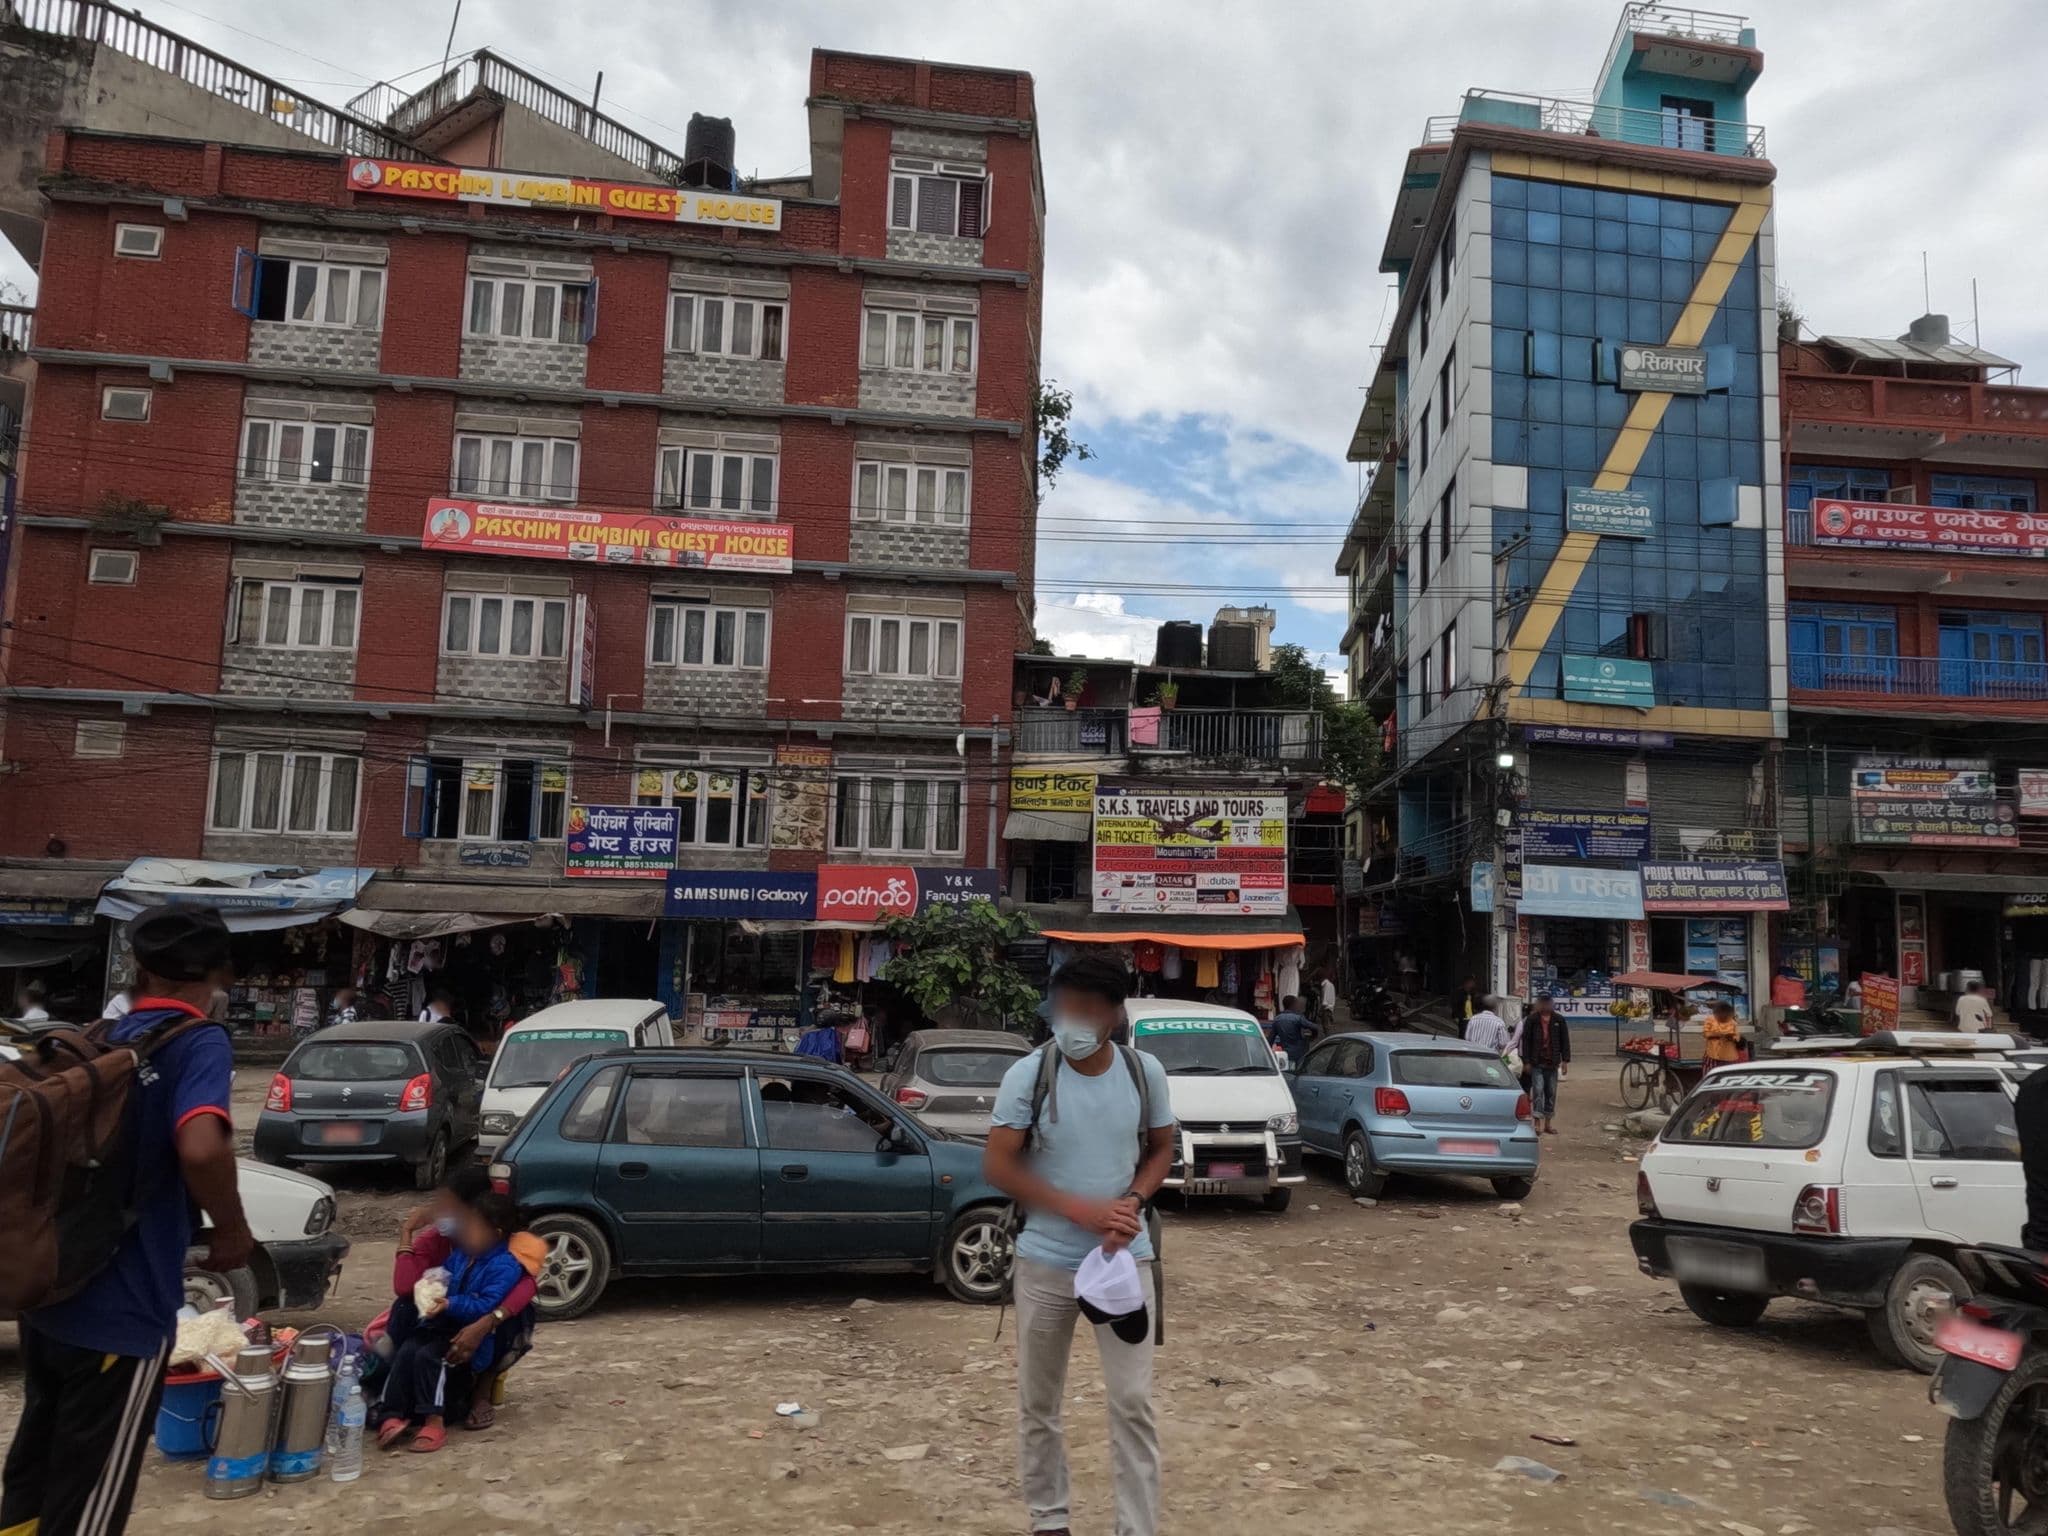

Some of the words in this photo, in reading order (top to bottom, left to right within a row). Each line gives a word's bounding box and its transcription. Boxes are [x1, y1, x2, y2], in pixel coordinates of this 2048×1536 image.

[384, 166, 492, 197] PASCHIM
[502, 178, 602, 208] LUMBINI
[609, 188, 685, 215] GUEST
[696, 198, 776, 225] HOUSE
[1641, 351, 1706, 374] सिमसार
[475, 517, 561, 541] PASCHIM
[567, 523, 651, 548] LUMBINI
[656, 530, 720, 551] GUEST
[724, 535, 789, 556] HOUSE
[1053, 773, 1092, 792] टिकट
[1900, 783, 1924, 792] HOME
[1098, 799, 1133, 816] S.K.S.
[1137, 799, 1191, 817] TRAVELS
[1193, 800, 1219, 817] AND
[1223, 800, 1264, 817] TOURS
[590, 809, 629, 832] पश्चिम
[633, 810, 674, 837] लुम्बिनी
[1097, 820, 1151, 829] INTERNATIONAL
[588, 831, 622, 852] गेष्ट
[629, 836, 674, 855] हाउस
[1097, 831, 1112, 843] AIR
[1113, 831, 1145, 843] TICKET
[1156, 847, 1193, 857] Mountain
[1194, 847, 1216, 859] Flight
[944, 875, 953, 887] Y
[954, 875, 963, 887] &
[964, 875, 974, 887] K
[1155, 875, 1183, 885] QATAR
[1643, 866, 1674, 881] PRIDE
[1674, 866, 1705, 881] NEPAL
[673, 887, 749, 901] SAMSUNG
[757, 888, 809, 905] Galaxy
[823, 885, 912, 909] pathao
[925, 889, 960, 904] Fancy
[960, 890, 992, 902] Store
[1691, 1111, 1721, 1137] TAXI
[1750, 1113, 1765, 1142] TAXI
